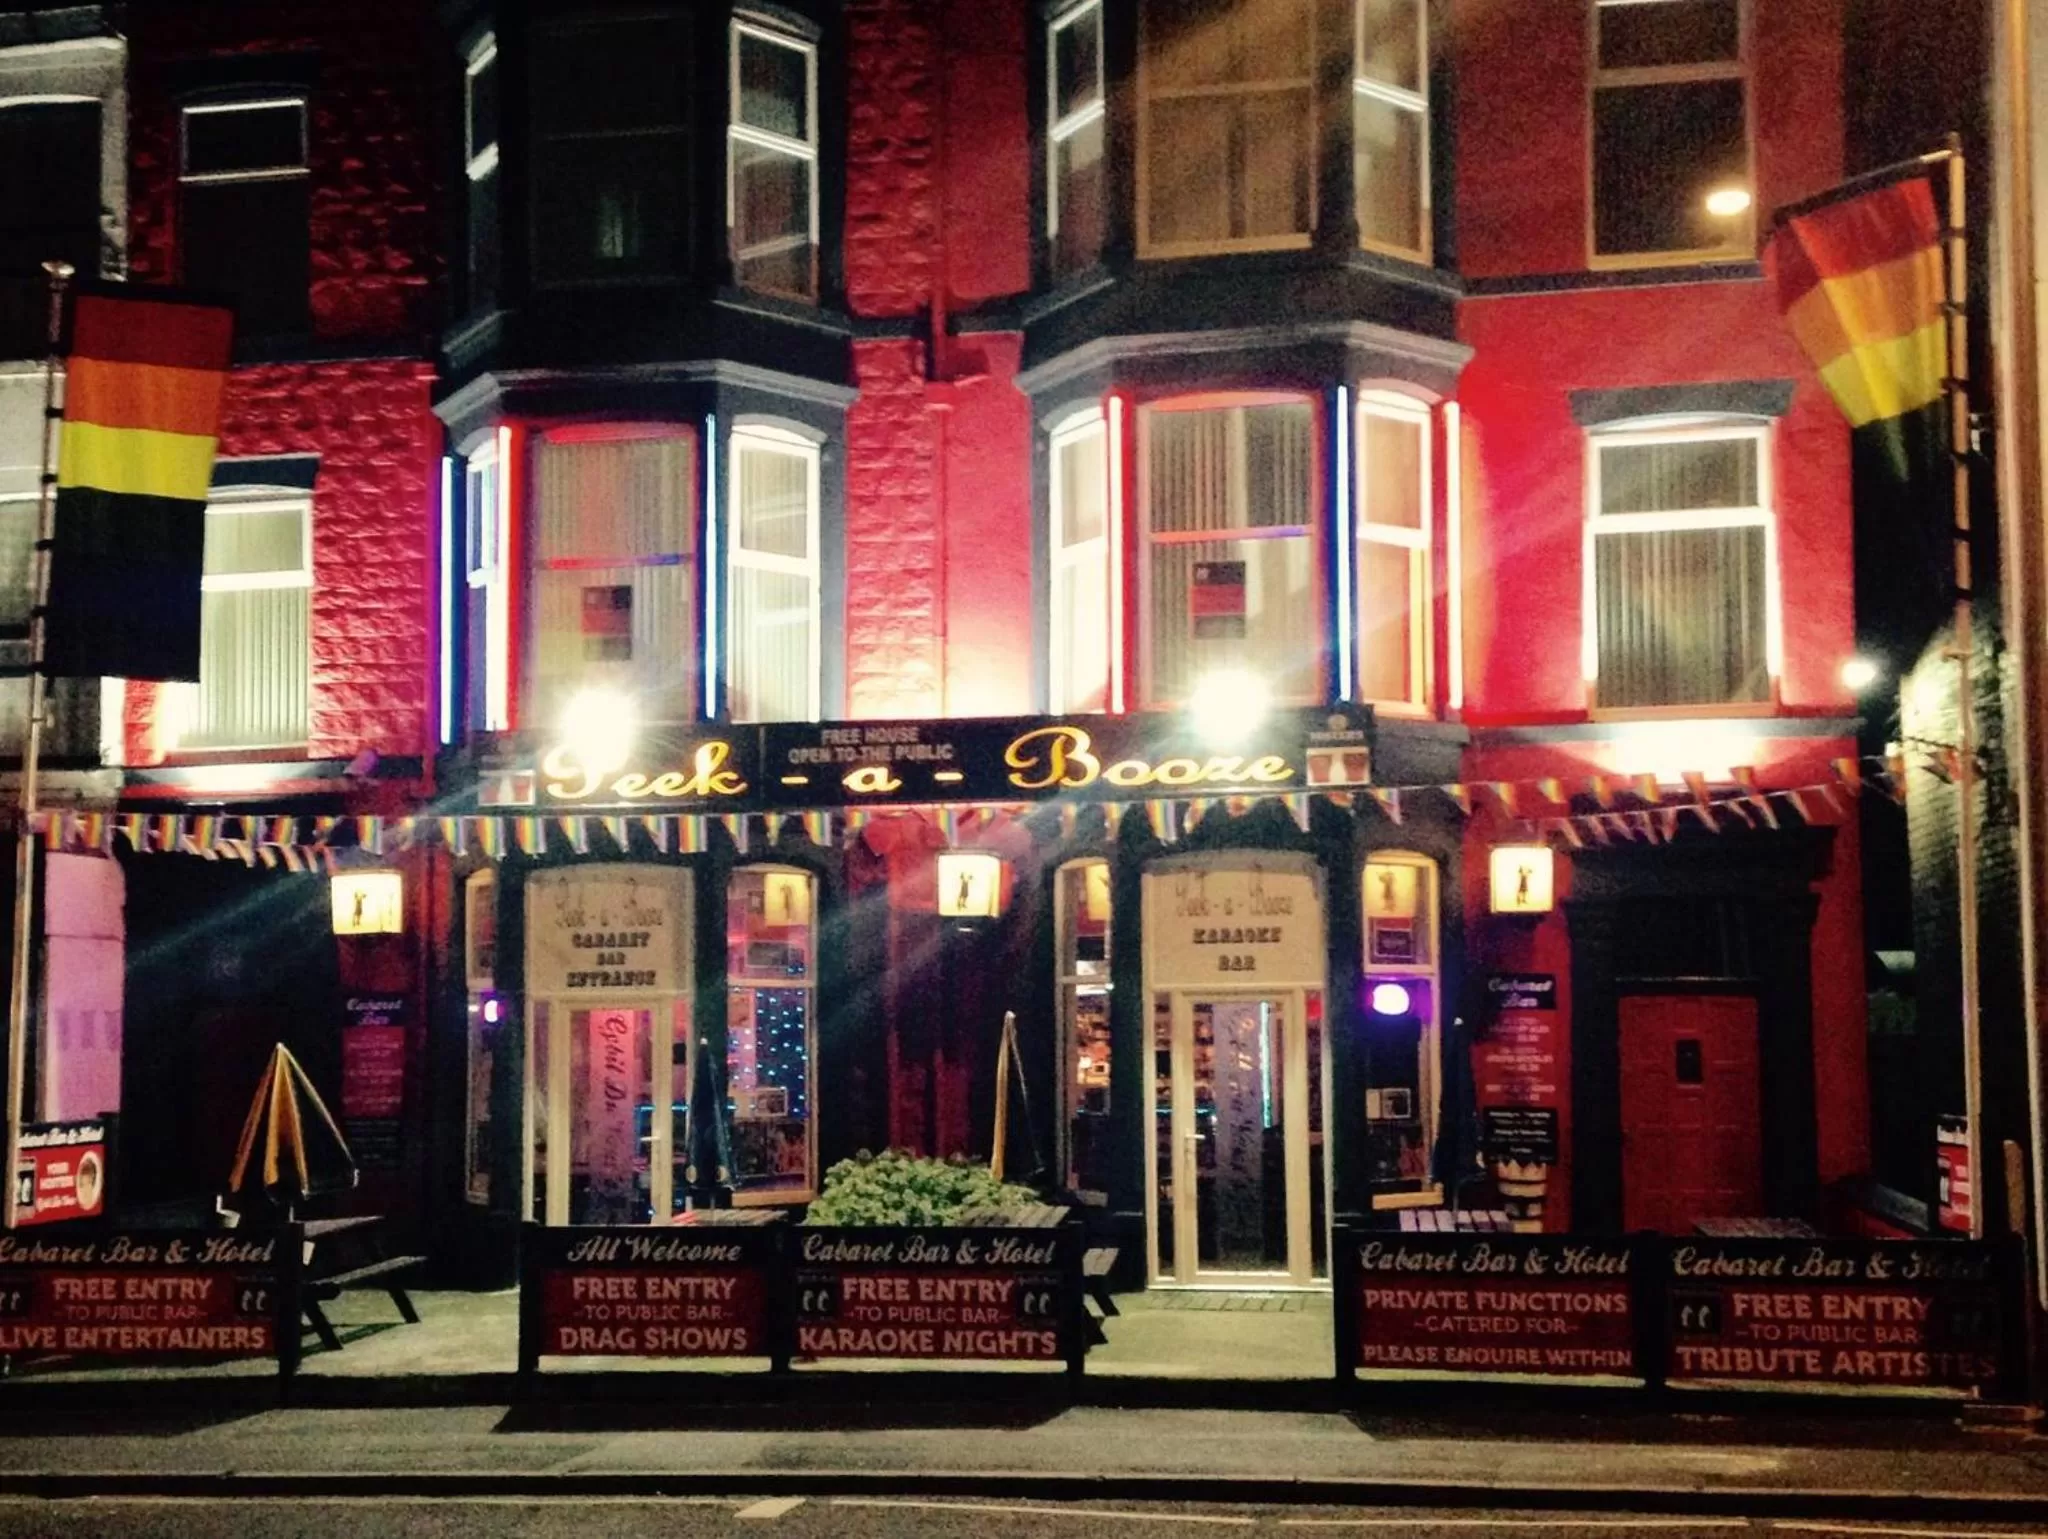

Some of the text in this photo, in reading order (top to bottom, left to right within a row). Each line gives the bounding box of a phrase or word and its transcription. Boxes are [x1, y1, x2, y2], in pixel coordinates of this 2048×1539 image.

[822, 728, 862, 745] FREE
[1004, 725, 1296, 790] Booze
[571, 931, 651, 949] CABARET
[1192, 926, 1282, 944] KARAOKE
[596, 951, 626, 966] BAR
[1218, 954, 1257, 972] BAR
[566, 969, 657, 988] ENTRANCE
[0, 1236, 276, 1265] Cabaret Bar & Hotel
[567, 1235, 743, 1262] All Welcome
[803, 1233, 1057, 1265] Cabaret Bar & Hotel
[1360, 1241, 1631, 1275] Cabaret Bar & Hotel
[1672, 1246, 1785, 1278] Cabaret
[1792, 1246, 1856, 1278] Bar
[1866, 1251, 1893, 1280] &
[52, 1278, 213, 1301] FREE ENTRY
[572, 1277, 737, 1300] FREE ENTRY
[843, 1277, 911, 1301] FREE
[917, 1278, 1015, 1302] ENTRY
[96, 1304, 158, 1322] PUBLIC
[616, 1304, 682, 1321] PUBLIC
[1363, 1289, 1628, 1314] PRIVATE FUNCTIONS
[1732, 1292, 1934, 1322] FREE ENTRY
[888, 1305, 956, 1323] PUBLIC
[0, 1326, 266, 1350] LIVE ENTERTAINERS
[559, 1326, 748, 1351] DRAG SHOWS
[800, 1327, 1057, 1355] KARAOKE NIGHTS
[1788, 1324, 1868, 1343] PUBLIC
[1363, 1344, 1633, 1368] PLEASE ENQUIRE WITHIN
[1676, 1345, 1823, 1375] TRIBUTE
